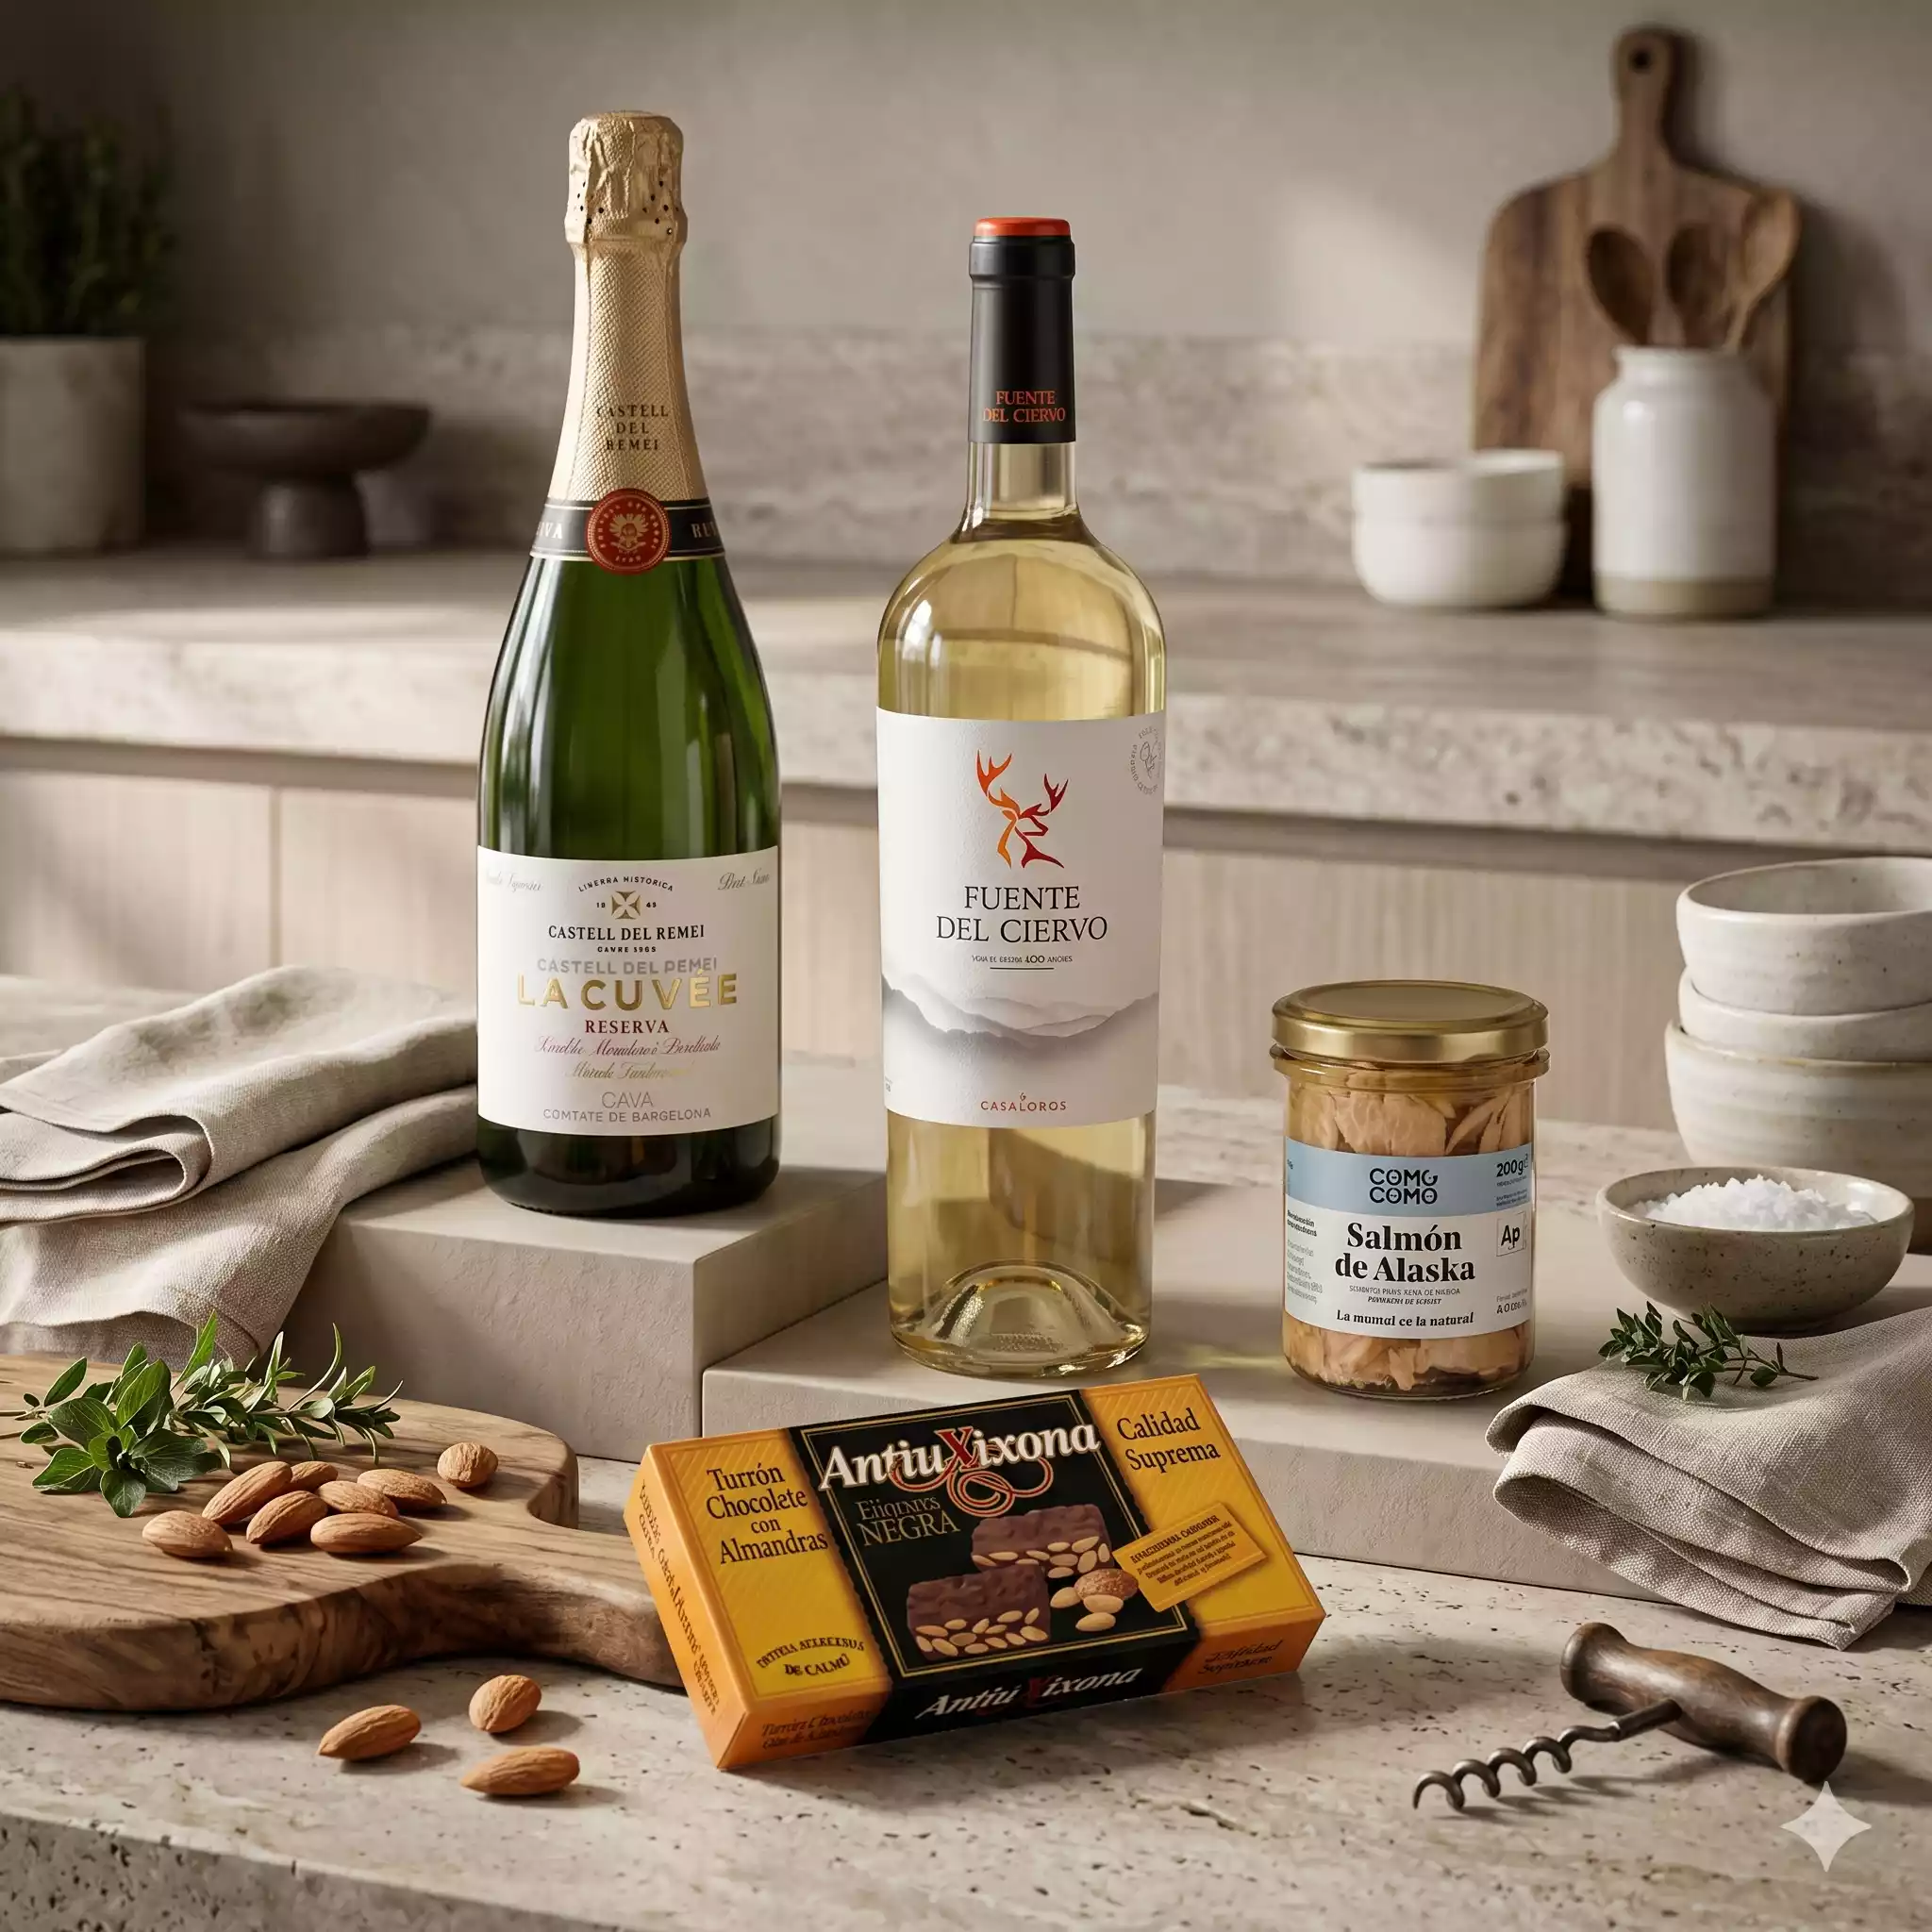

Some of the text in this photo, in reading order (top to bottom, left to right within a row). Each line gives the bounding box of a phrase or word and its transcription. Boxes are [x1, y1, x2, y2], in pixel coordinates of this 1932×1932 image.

[995, 391, 1056, 405] FUENTE
[596, 405, 669, 417] CASTELL
[983, 408, 1066, 423] DEL CIERVO
[616, 423, 649, 434] DEL
[606, 440, 658, 451] REMEI
[964, 886, 1081, 910] FUENTE
[548, 924, 705, 941] CASTELL DEL REMEI
[937, 916, 1108, 943] DEL CIERVO
[537, 958, 613, 975] CASTELL
[624, 960, 658, 975] DEL
[518, 969, 738, 1011] LA CUVÉE
[585, 1019, 670, 1034] RESERVA
[601, 1091, 654, 1108] CAVA
[542, 1108, 604, 1123] COMTATE
[609, 1111, 627, 1123] DE
[1369, 1187, 1439, 1205] COMO
[1347, 1222, 1462, 1252] Salmón
[1335, 1252, 1368, 1279] de
[1373, 1256, 1476, 1283] Alaska
[1336, 1309, 1351, 1322] La
[1416, 1316, 1426, 1326] la
[1429, 1311, 1474, 1327] natural
[1116, 1407, 1202, 1441] Calidad
[1124, 1441, 1222, 1474] Suprema
[707, 1462, 786, 1491] Turrón
[706, 1487, 808, 1520] Chocolate
[750, 1518, 782, 1534] con
[856, 1509, 961, 1546] NEGRA
[720, 1528, 828, 1565] Almandras
